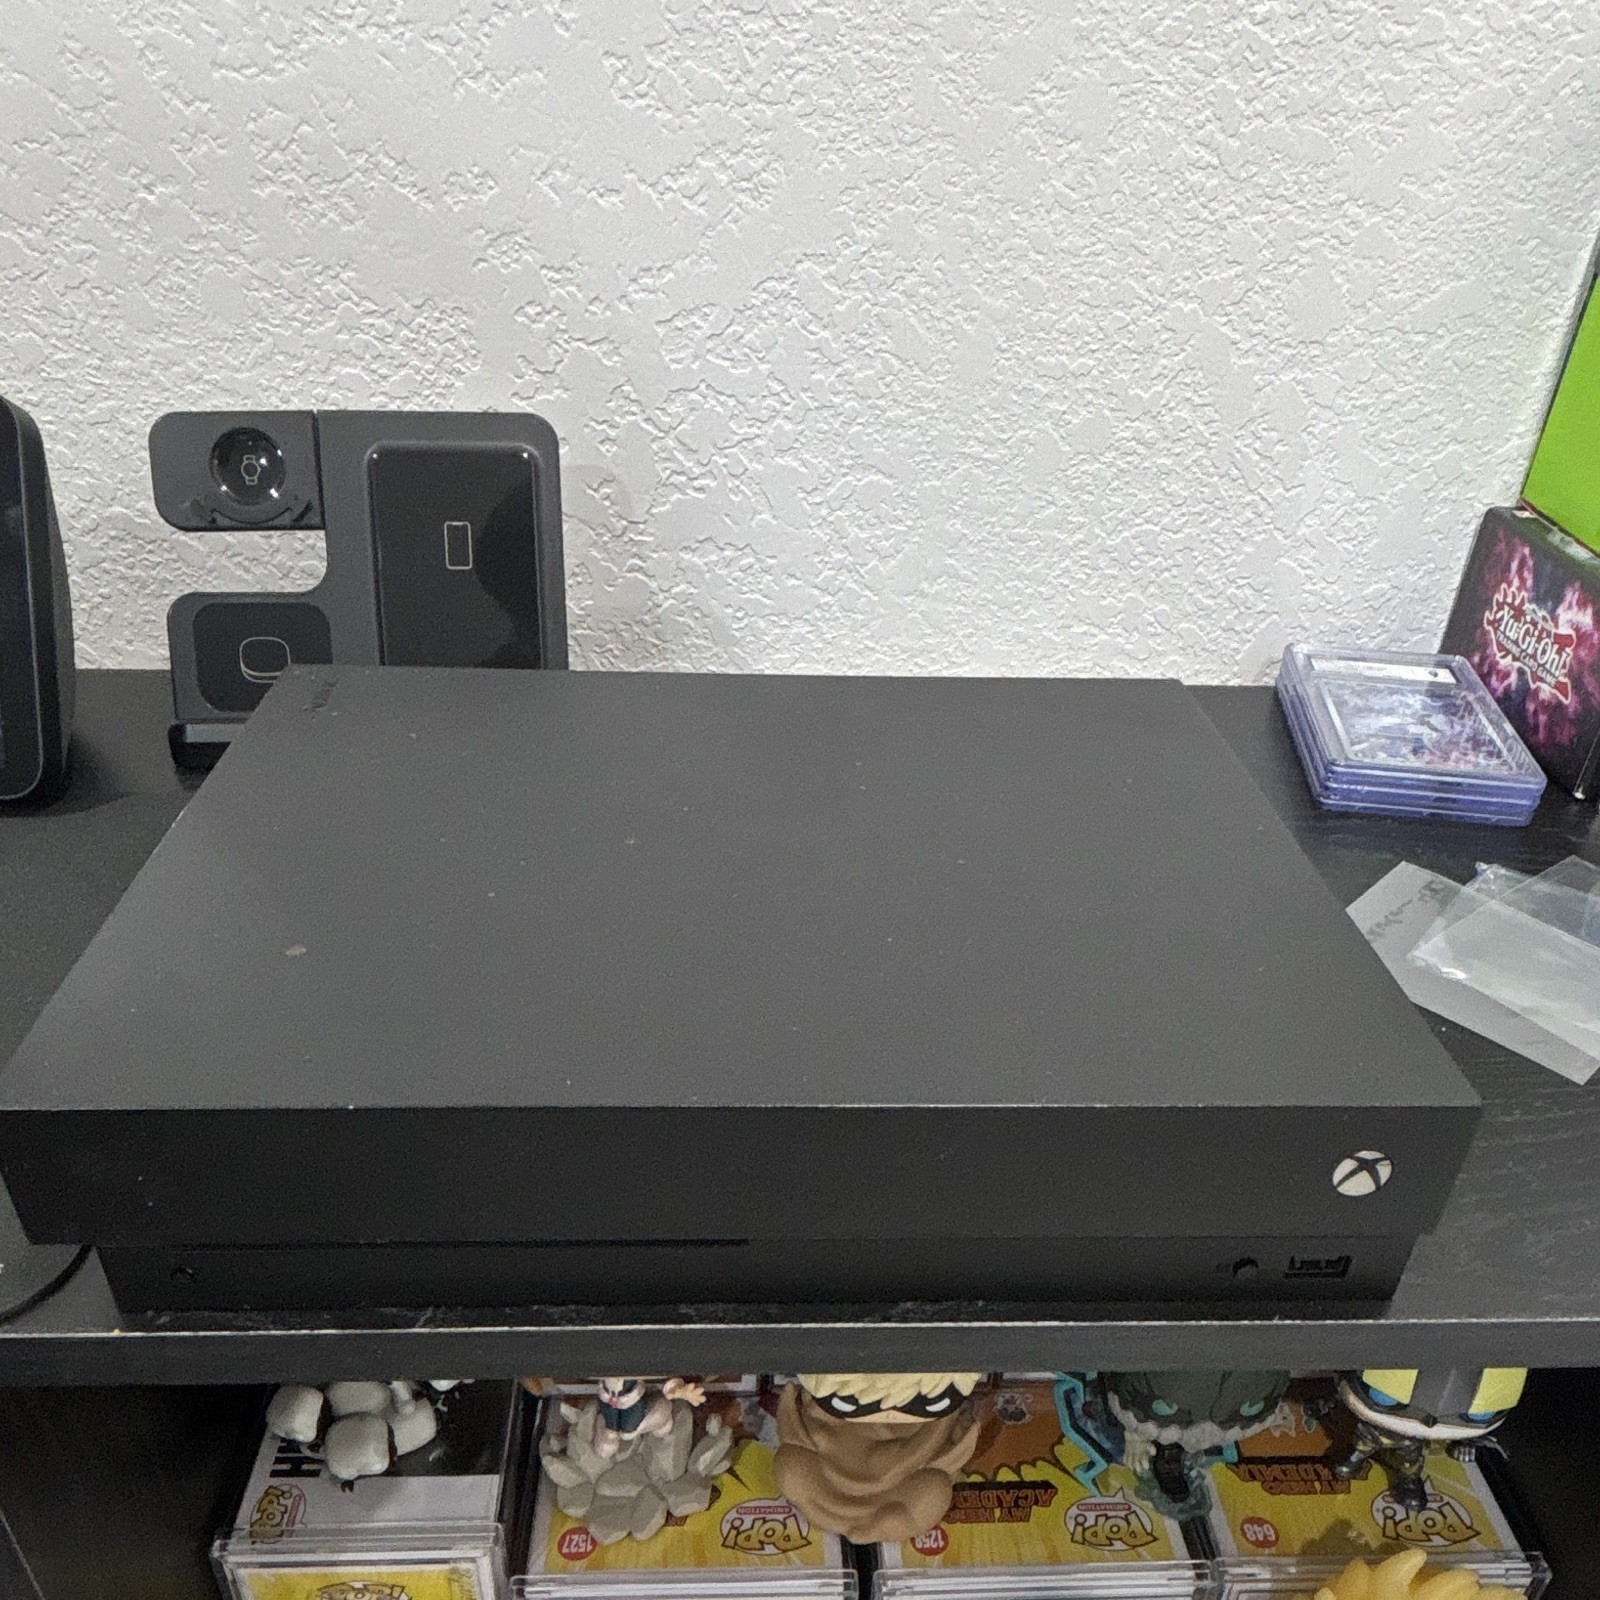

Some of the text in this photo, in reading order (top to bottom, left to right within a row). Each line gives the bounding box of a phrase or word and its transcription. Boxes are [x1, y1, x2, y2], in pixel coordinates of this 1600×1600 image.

[1495, 604, 1572, 679] Yu-Gi-Oh!
[1520, 651, 1538, 672] CARD
[1537, 667, 1558, 688] GAME
[736, 1505, 792, 1515] ANIMATION
[998, 1507, 1032, 1523] MY
[1383, 1502, 1481, 1543] POP!
[562, 1533, 595, 1555] 1527
[722, 1514, 812, 1553] POP!
[1070, 1510, 1160, 1549] POP!
[1244, 1523, 1277, 1542] 648
